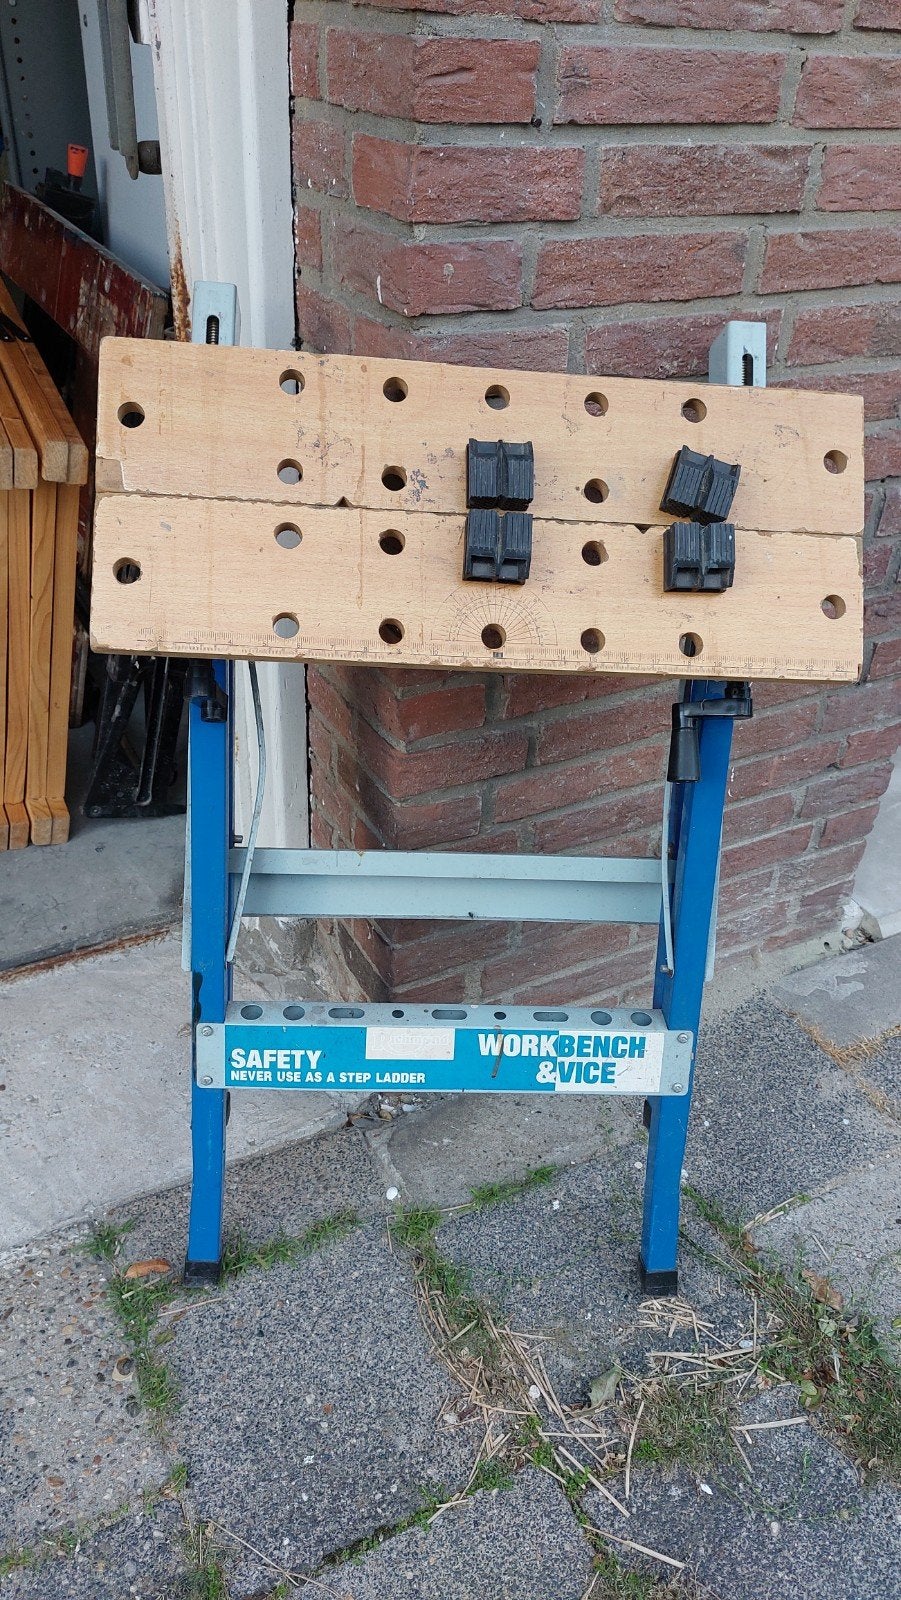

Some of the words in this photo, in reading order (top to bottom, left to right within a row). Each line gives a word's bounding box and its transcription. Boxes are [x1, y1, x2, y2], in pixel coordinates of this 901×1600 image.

[478, 1034, 646, 1058] WORKBENCH
[231, 1048, 322, 1069] SAFETY
[231, 1070, 272, 1082] NEVER
[277, 1071, 301, 1083] USE
[305, 1071, 322, 1083] AS
[326, 1072, 335, 1083] A
[339, 1072, 371, 1083] STEP
[376, 1072, 425, 1084] LADDER
[536, 1061, 616, 1084] &VICE
